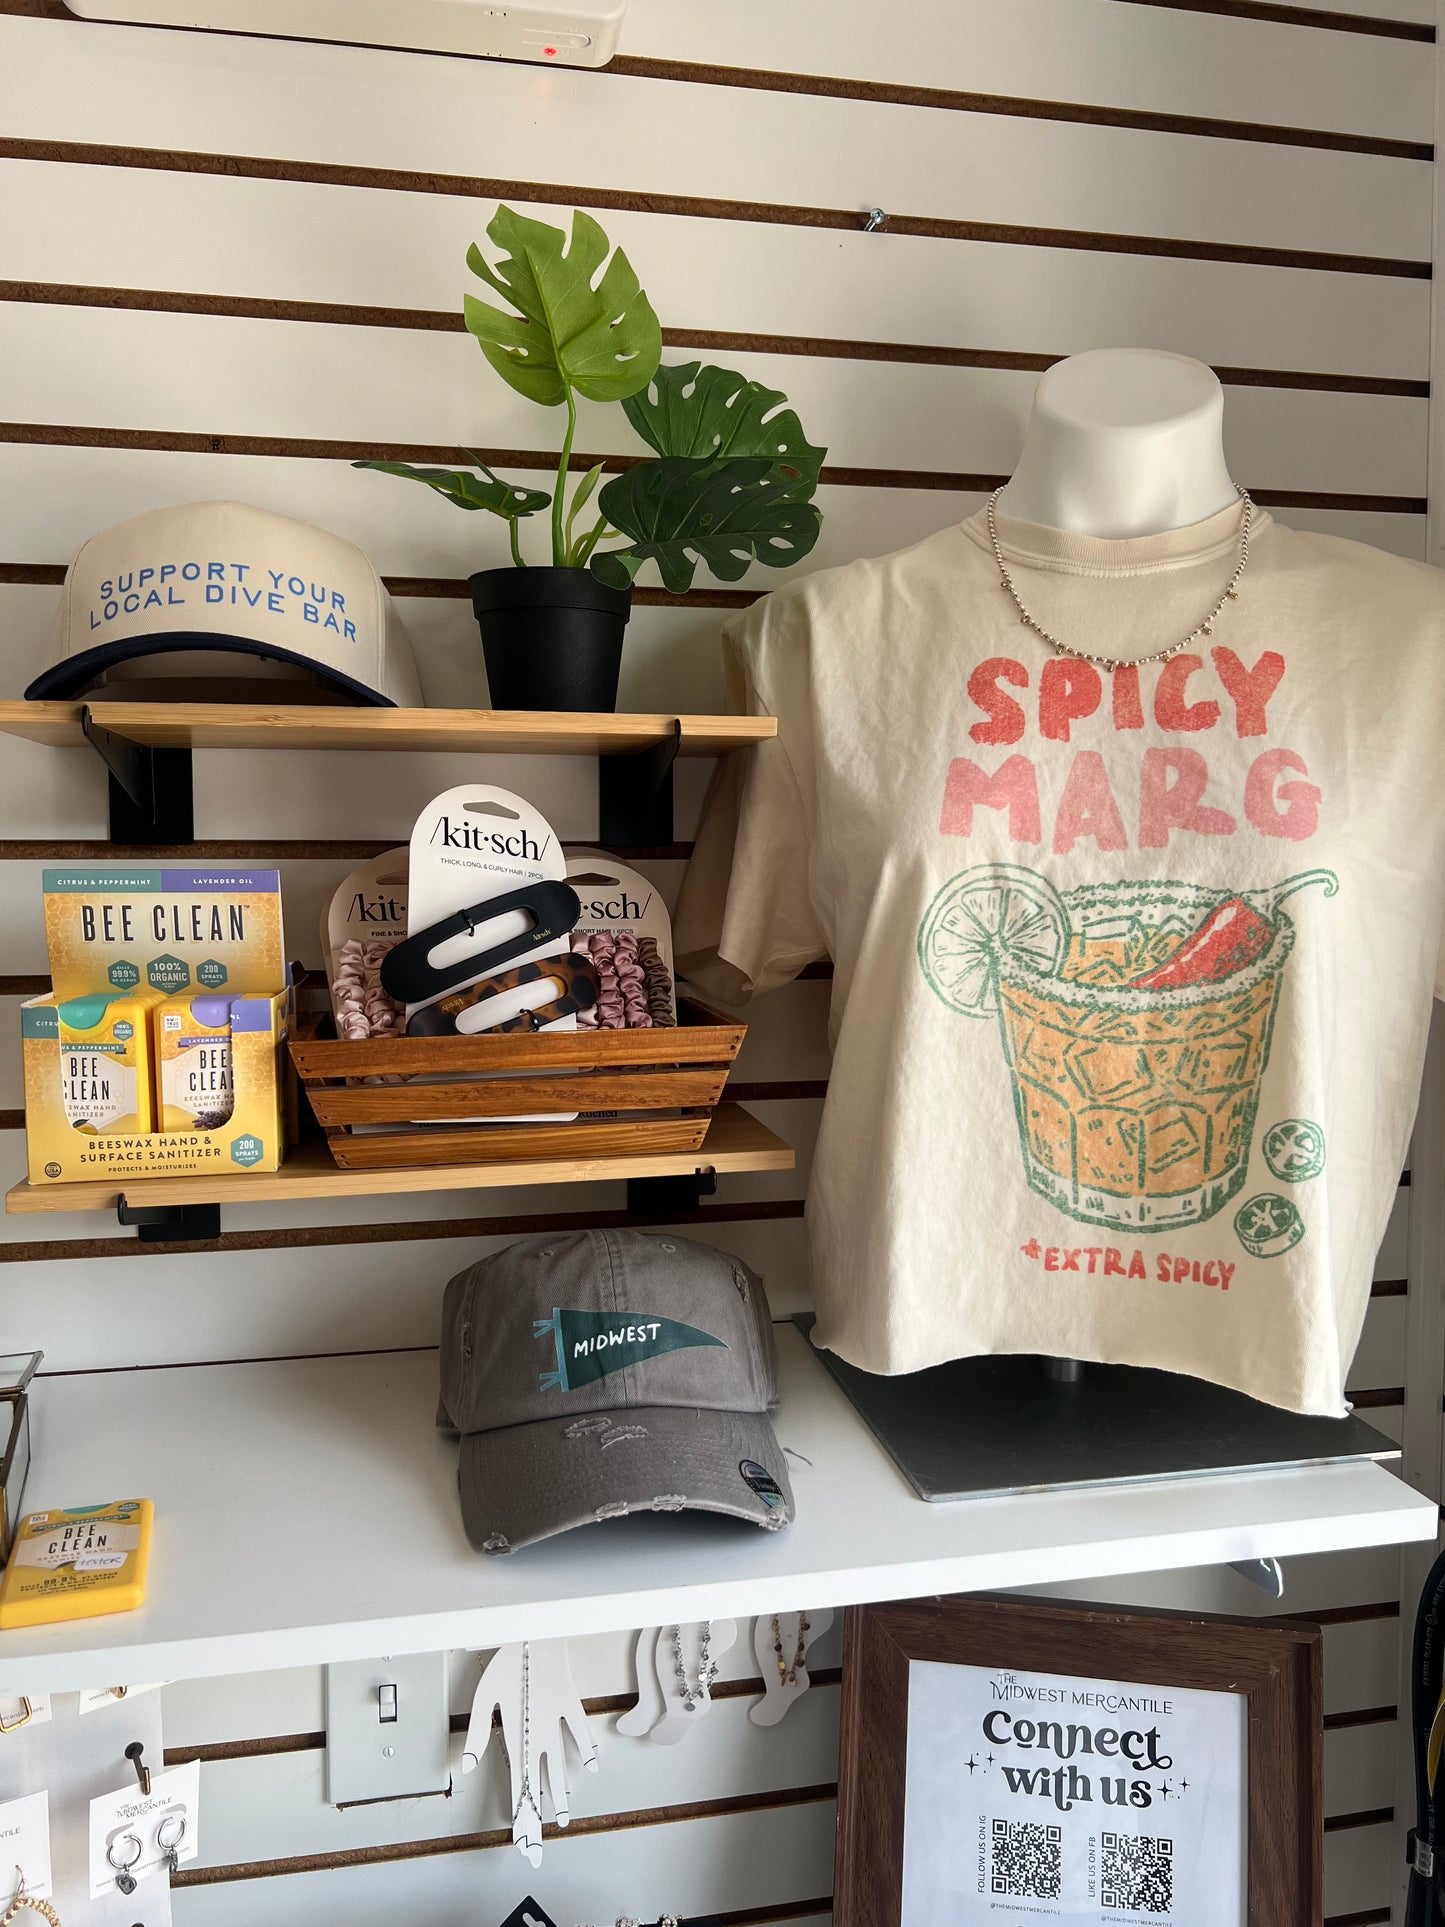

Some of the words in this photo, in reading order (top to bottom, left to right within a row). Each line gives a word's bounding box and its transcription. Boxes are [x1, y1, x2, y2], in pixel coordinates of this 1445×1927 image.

[100, 562, 250, 600] SUPPORT
[268, 569, 346, 613] YOUR
[90, 586, 185, 630] LOCAL
[205, 584, 285, 614] DIVE
[303, 602, 357, 643] BAR
[967, 645, 1285, 746] SPICY
[938, 746, 1322, 855] MARG
[440, 857, 462, 866] THICK,
[462, 861, 482, 869] LONG,
[488, 865, 508, 873] CURLY
[509, 869, 523, 877] HAIR
[528, 872, 544, 880] 2PCS
[81, 905, 134, 942] BEE
[112, 969, 136, 978] 99.9%
[153, 962, 181, 971] 100%
[204, 964, 219, 973] 200
[150, 972, 188, 982] ORGANIC
[70, 1057, 98, 1077] BEE
[200, 1049, 227, 1069] BEE
[184, 1094, 221, 1102] BEESWAX
[89, 1139, 152, 1150] BEESWAX
[159, 1137, 198, 1147] HAND
[204, 1136, 212, 1144] &
[239, 1140, 255, 1150] 200
[80, 1152, 143, 1163] SURFACE
[149, 1148, 221, 1160] SANITIZER
[108, 1165, 142, 1173] PROTECTS
[1156, 1252, 1236, 1291] SPICY
[574, 1322, 661, 1358] MIDWEST
[63, 1524, 97, 1540] BEE
[48, 1534, 107, 1554] CLEAN
[997, 1672, 1017, 1685] THE
[989, 1680, 1068, 1703] MIDWEST
[1072, 1691, 1173, 1715] MERCANTILE
[982, 1709, 1173, 1771] Connect
[1001, 1765, 1094, 1812] with
[1099, 1775, 1152, 1809] us
[116, 1798, 154, 1819] MIDWEST
[125, 1796, 173, 1819] MERCANTILE
[979, 1815, 987, 1824] IG
[978, 1826, 986, 1841] ON
[1088, 1836, 1096, 1847] FB
[978, 1842, 986, 1854] US
[1088, 1849, 1096, 1863] ON
[977, 1855, 986, 1894] FOLLOW
[1088, 1864, 1096, 1877] US
[1088, 1879, 1096, 1898] LIKE
[990, 1902, 1061, 1916] @THEMIDWESTMERCANTILE
[1101, 1915, 1173, 1927] @THEMIDWESTMERCANTILE
